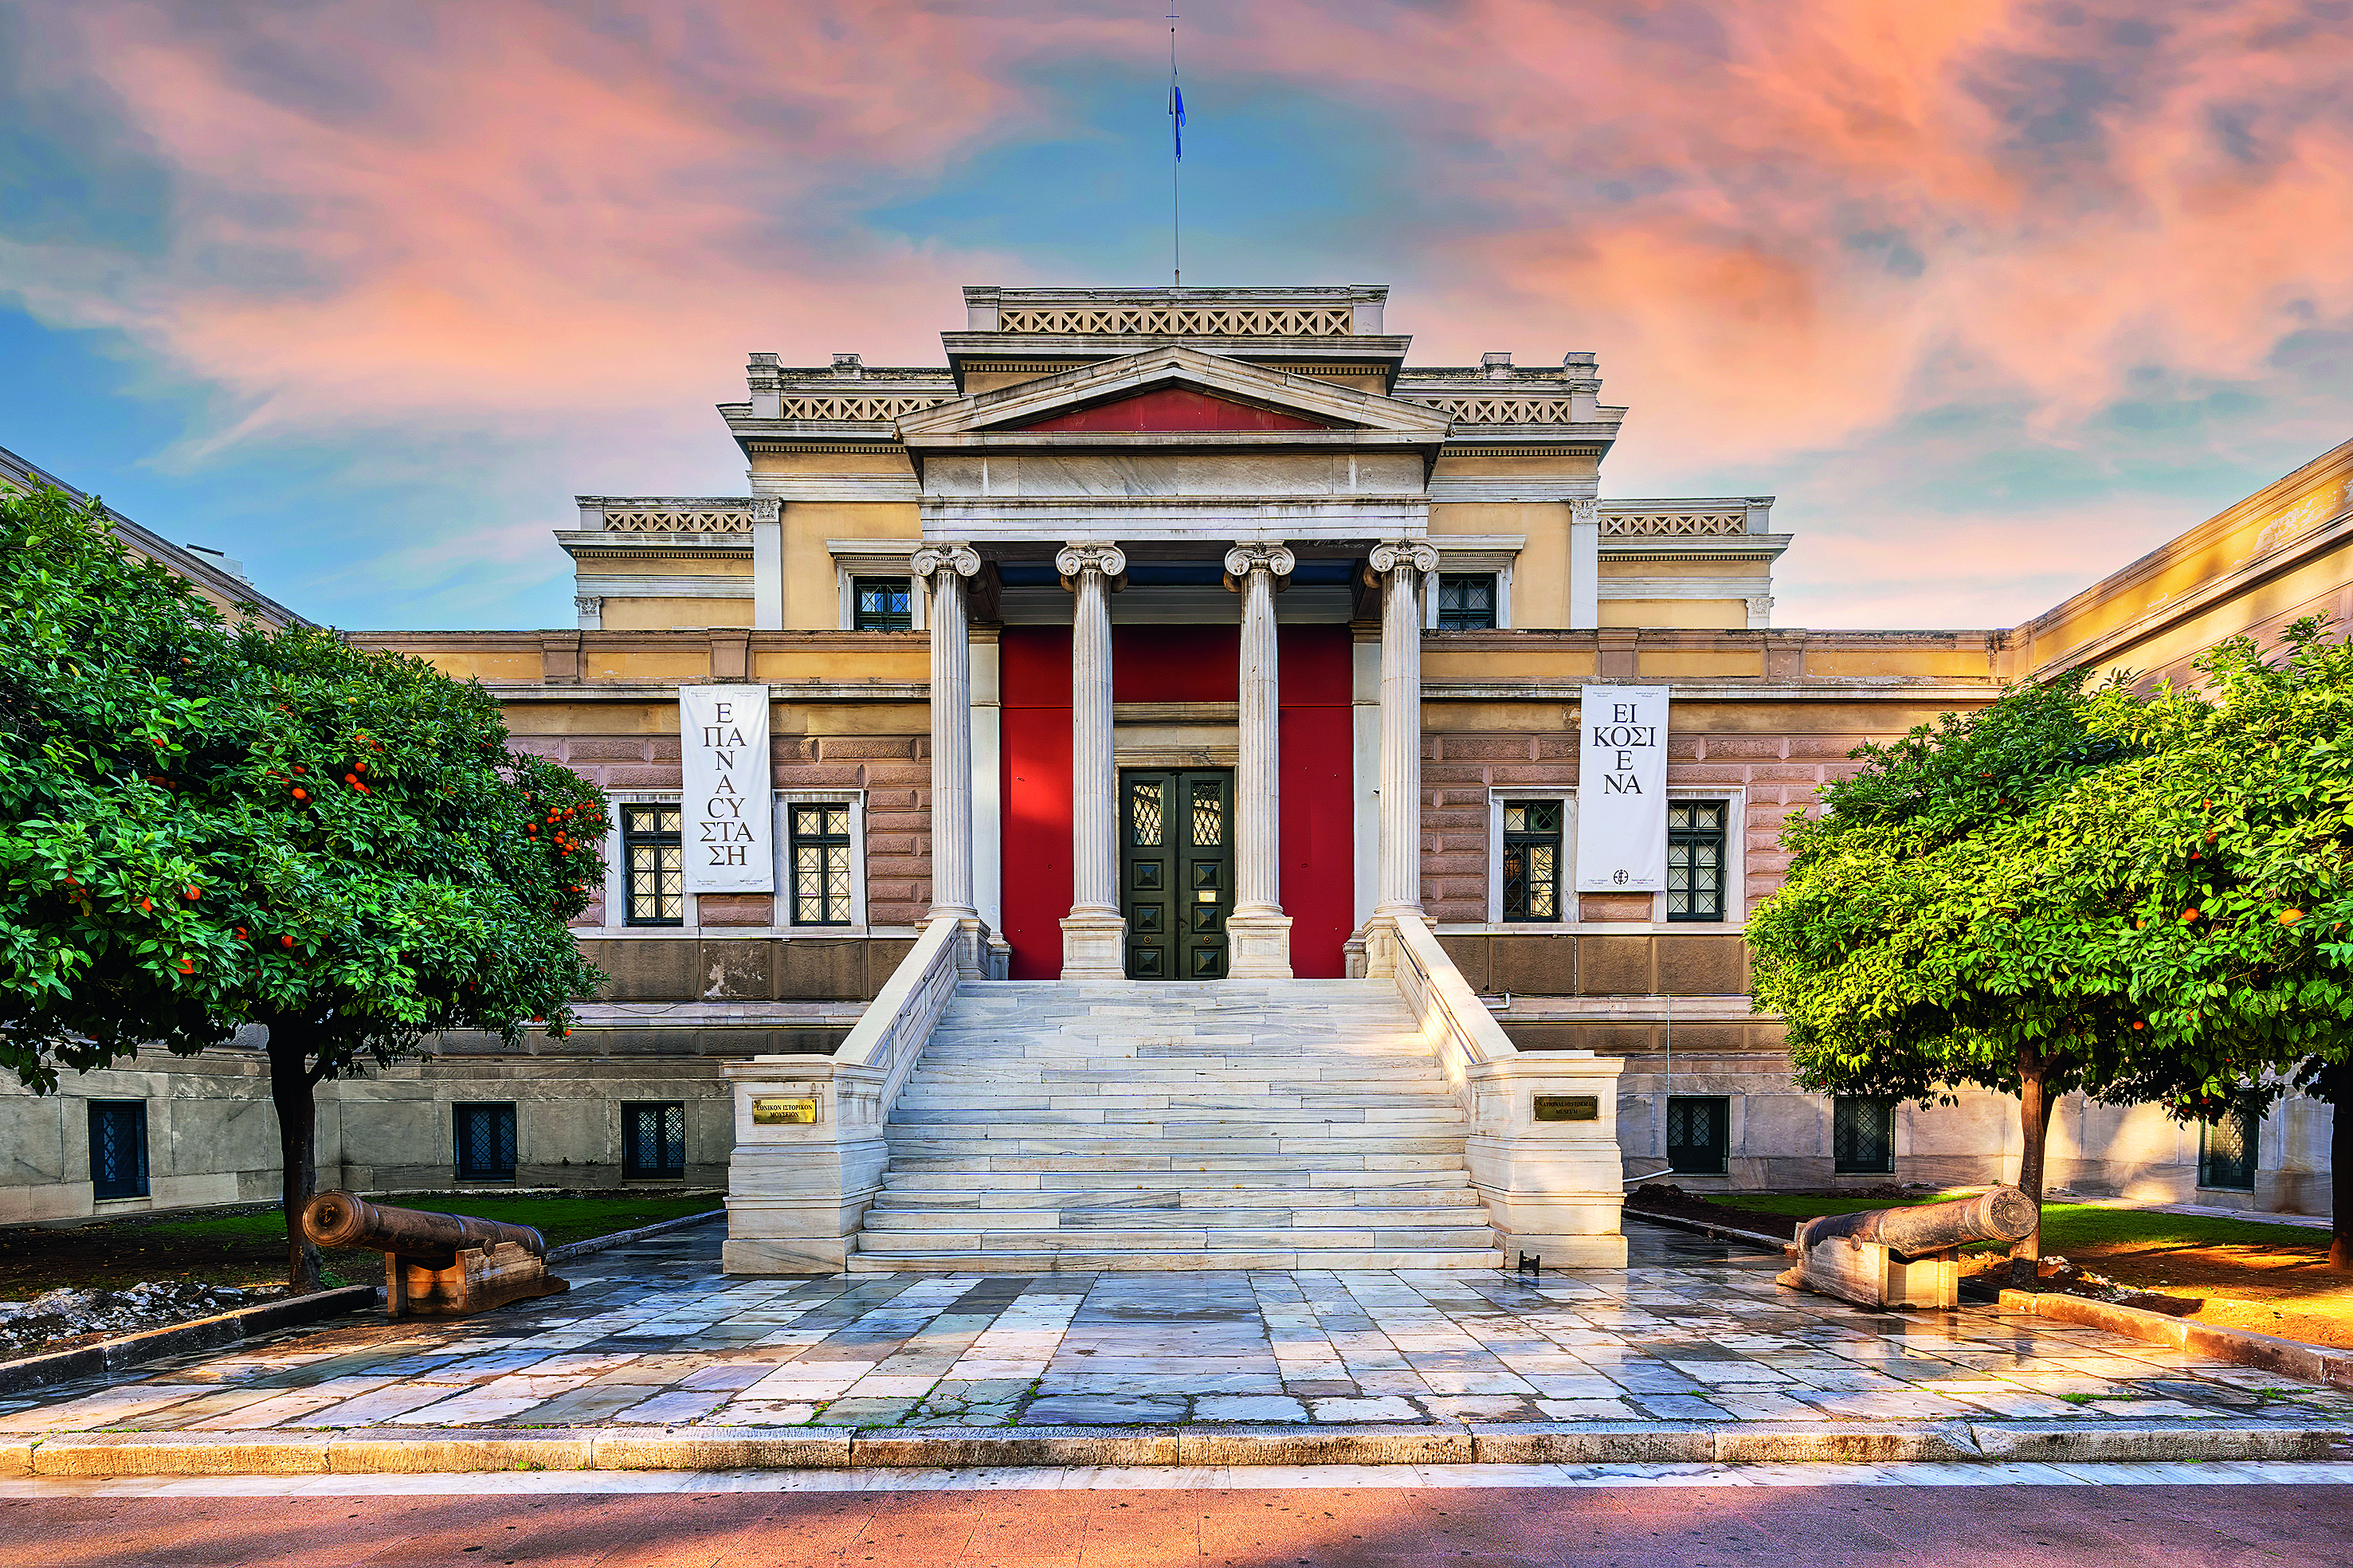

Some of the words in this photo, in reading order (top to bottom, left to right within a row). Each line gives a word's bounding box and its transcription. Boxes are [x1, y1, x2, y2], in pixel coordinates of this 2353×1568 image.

[715, 704, 733, 723] Ε
[1612, 704, 1637, 723] ΕΙ
[703, 727, 747, 747] ΠΑ
[1593, 727, 1656, 747] ΚΟΣΙ
[716, 751, 735, 770] Ν
[1615, 751, 1633, 770] Ε
[715, 774, 736, 794] Α
[1604, 774, 1643, 794] ΝΑ
[700, 822, 755, 841] ΣΤΑ
[708, 845, 747, 865] ΣΗ
